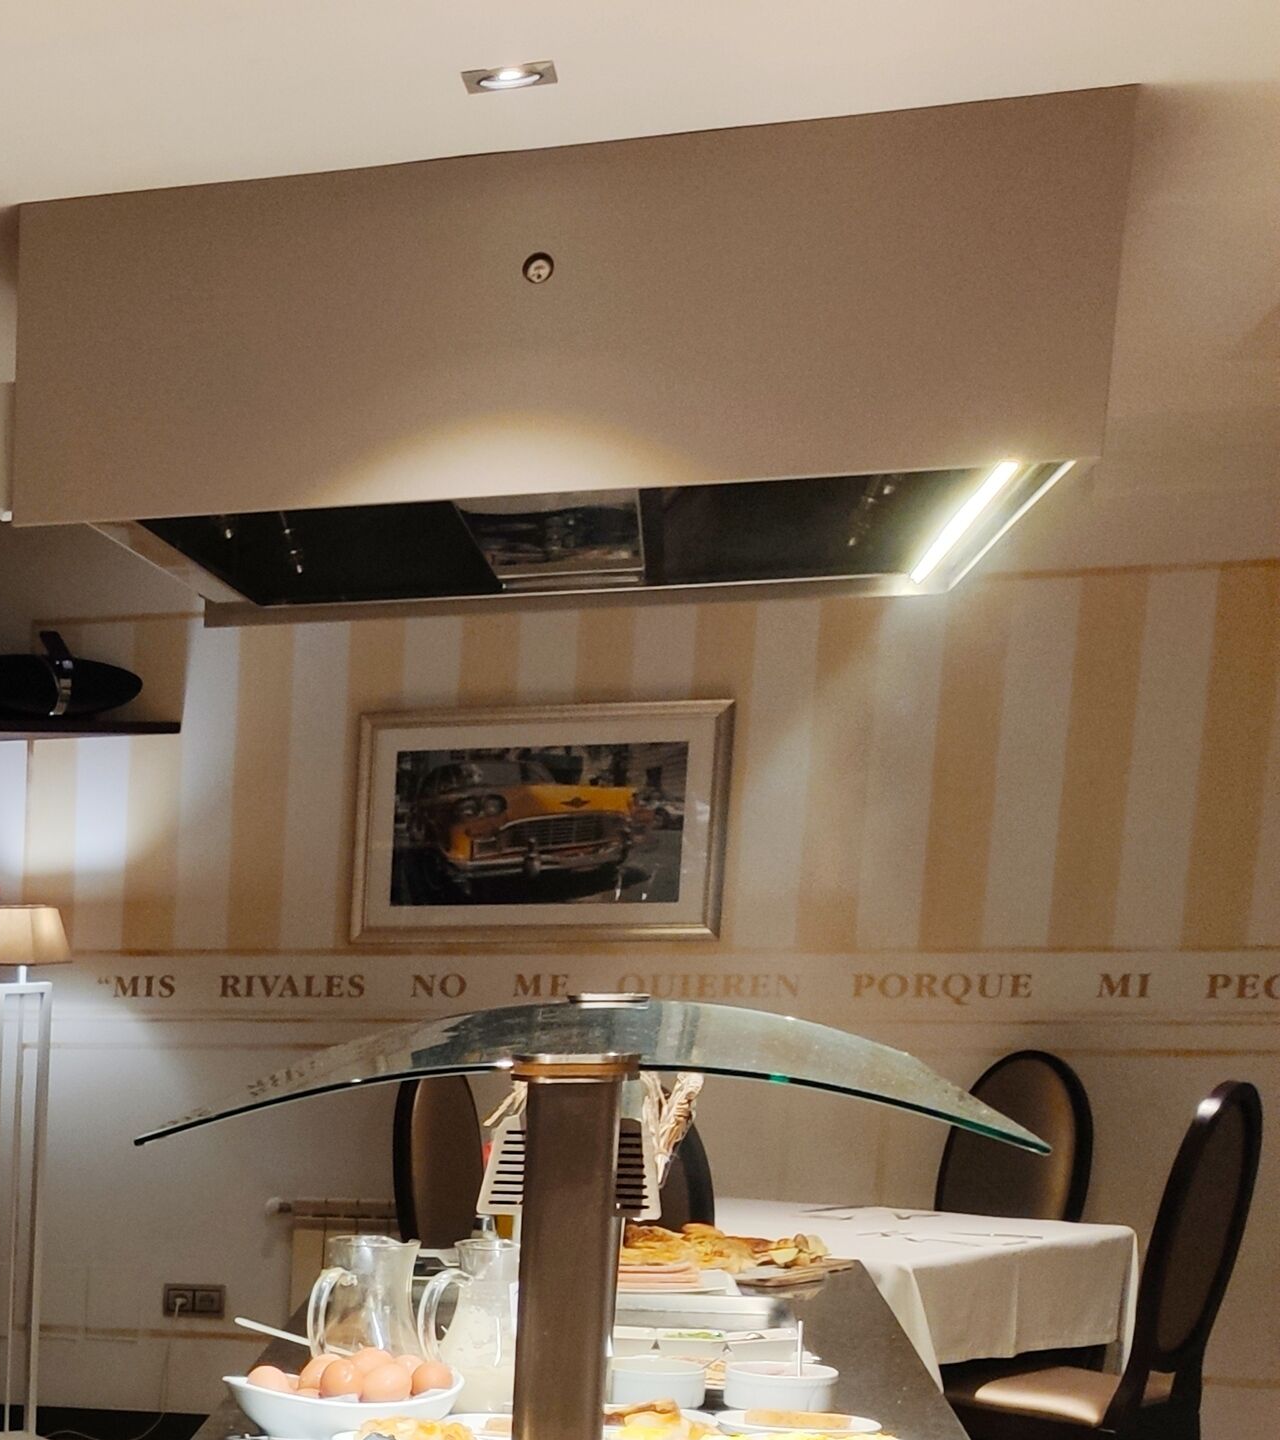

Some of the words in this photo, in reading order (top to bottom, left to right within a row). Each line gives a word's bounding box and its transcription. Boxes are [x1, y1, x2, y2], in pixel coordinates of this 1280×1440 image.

[219, 974, 366, 998] RIVALES
[411, 973, 468, 999] NO
[513, 973, 570, 998] ME
[617, 972, 801, 999] QUIEREN
[852, 972, 1033, 1005] PORQUE
[1096, 972, 1152, 998] MI
